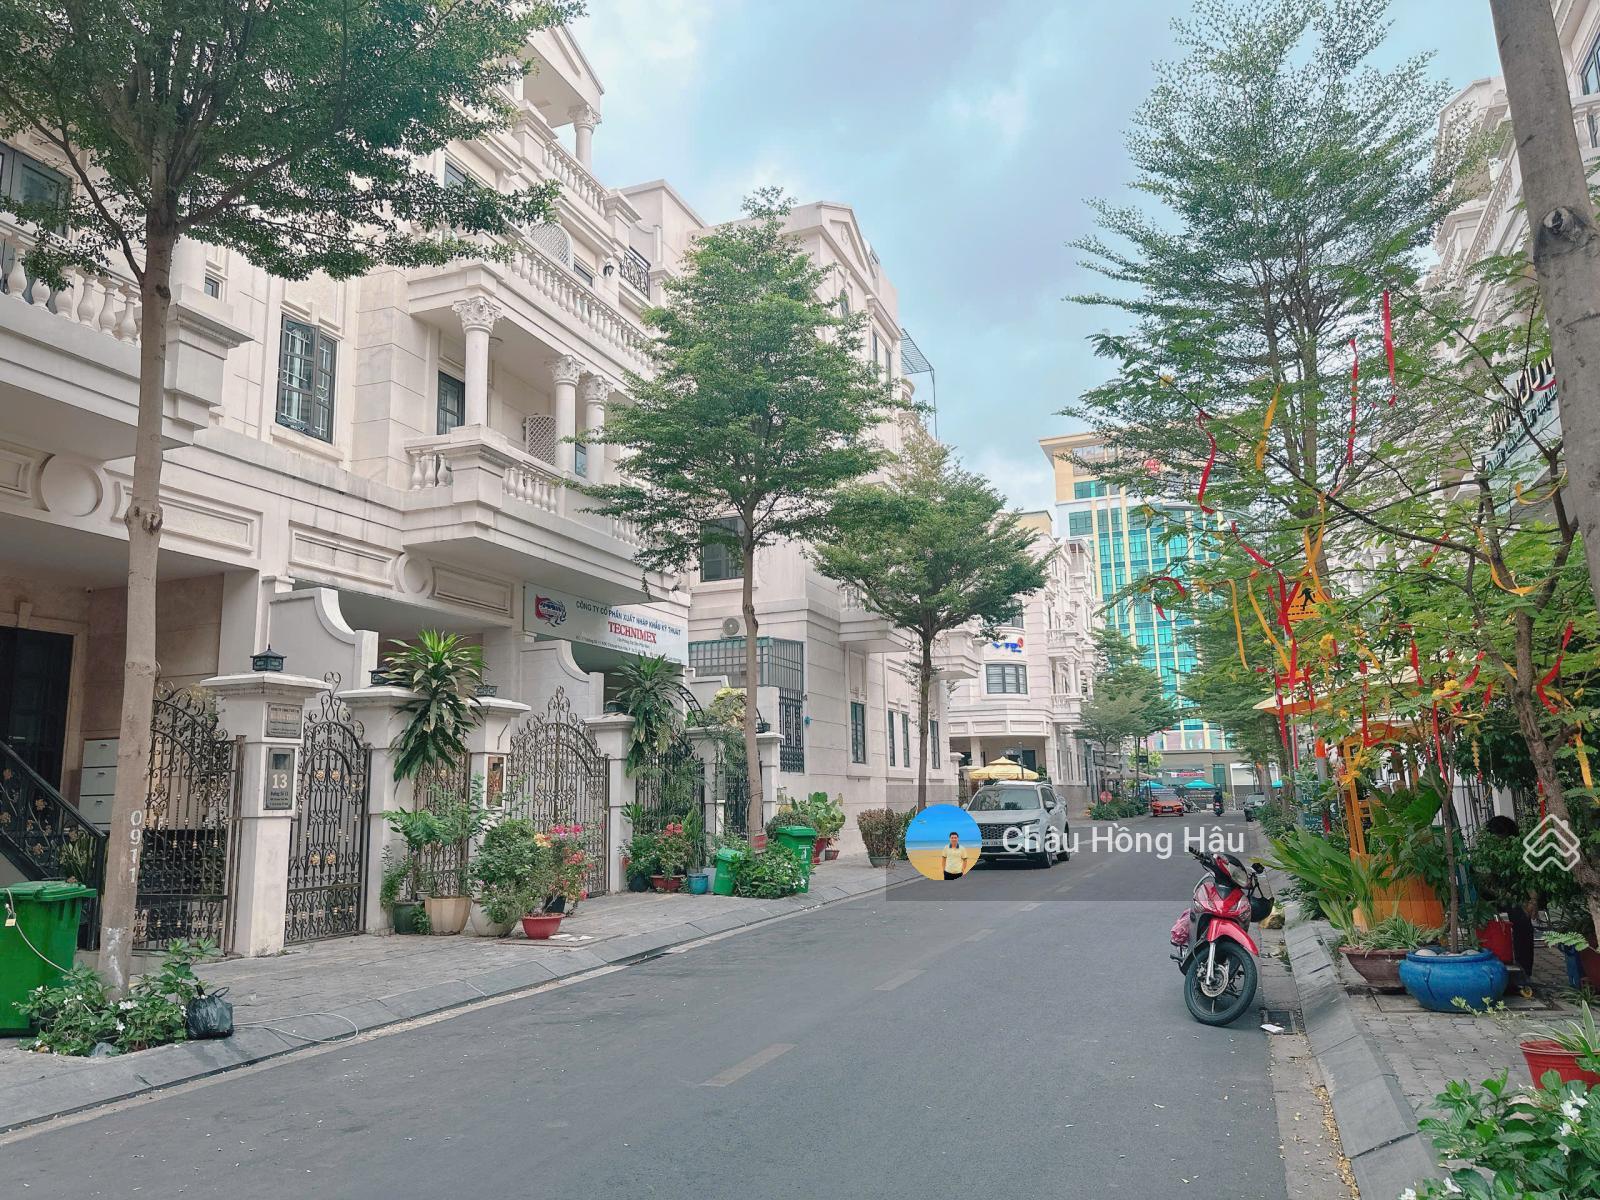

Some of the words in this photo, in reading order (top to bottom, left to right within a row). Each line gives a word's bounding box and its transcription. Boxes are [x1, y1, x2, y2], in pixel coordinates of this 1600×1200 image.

[576, 600, 592, 611] CÔNG
[607, 621, 657, 644] TECHNIMEX
[272, 773, 288, 789] 13
[129, 809, 143, 884] 0911
